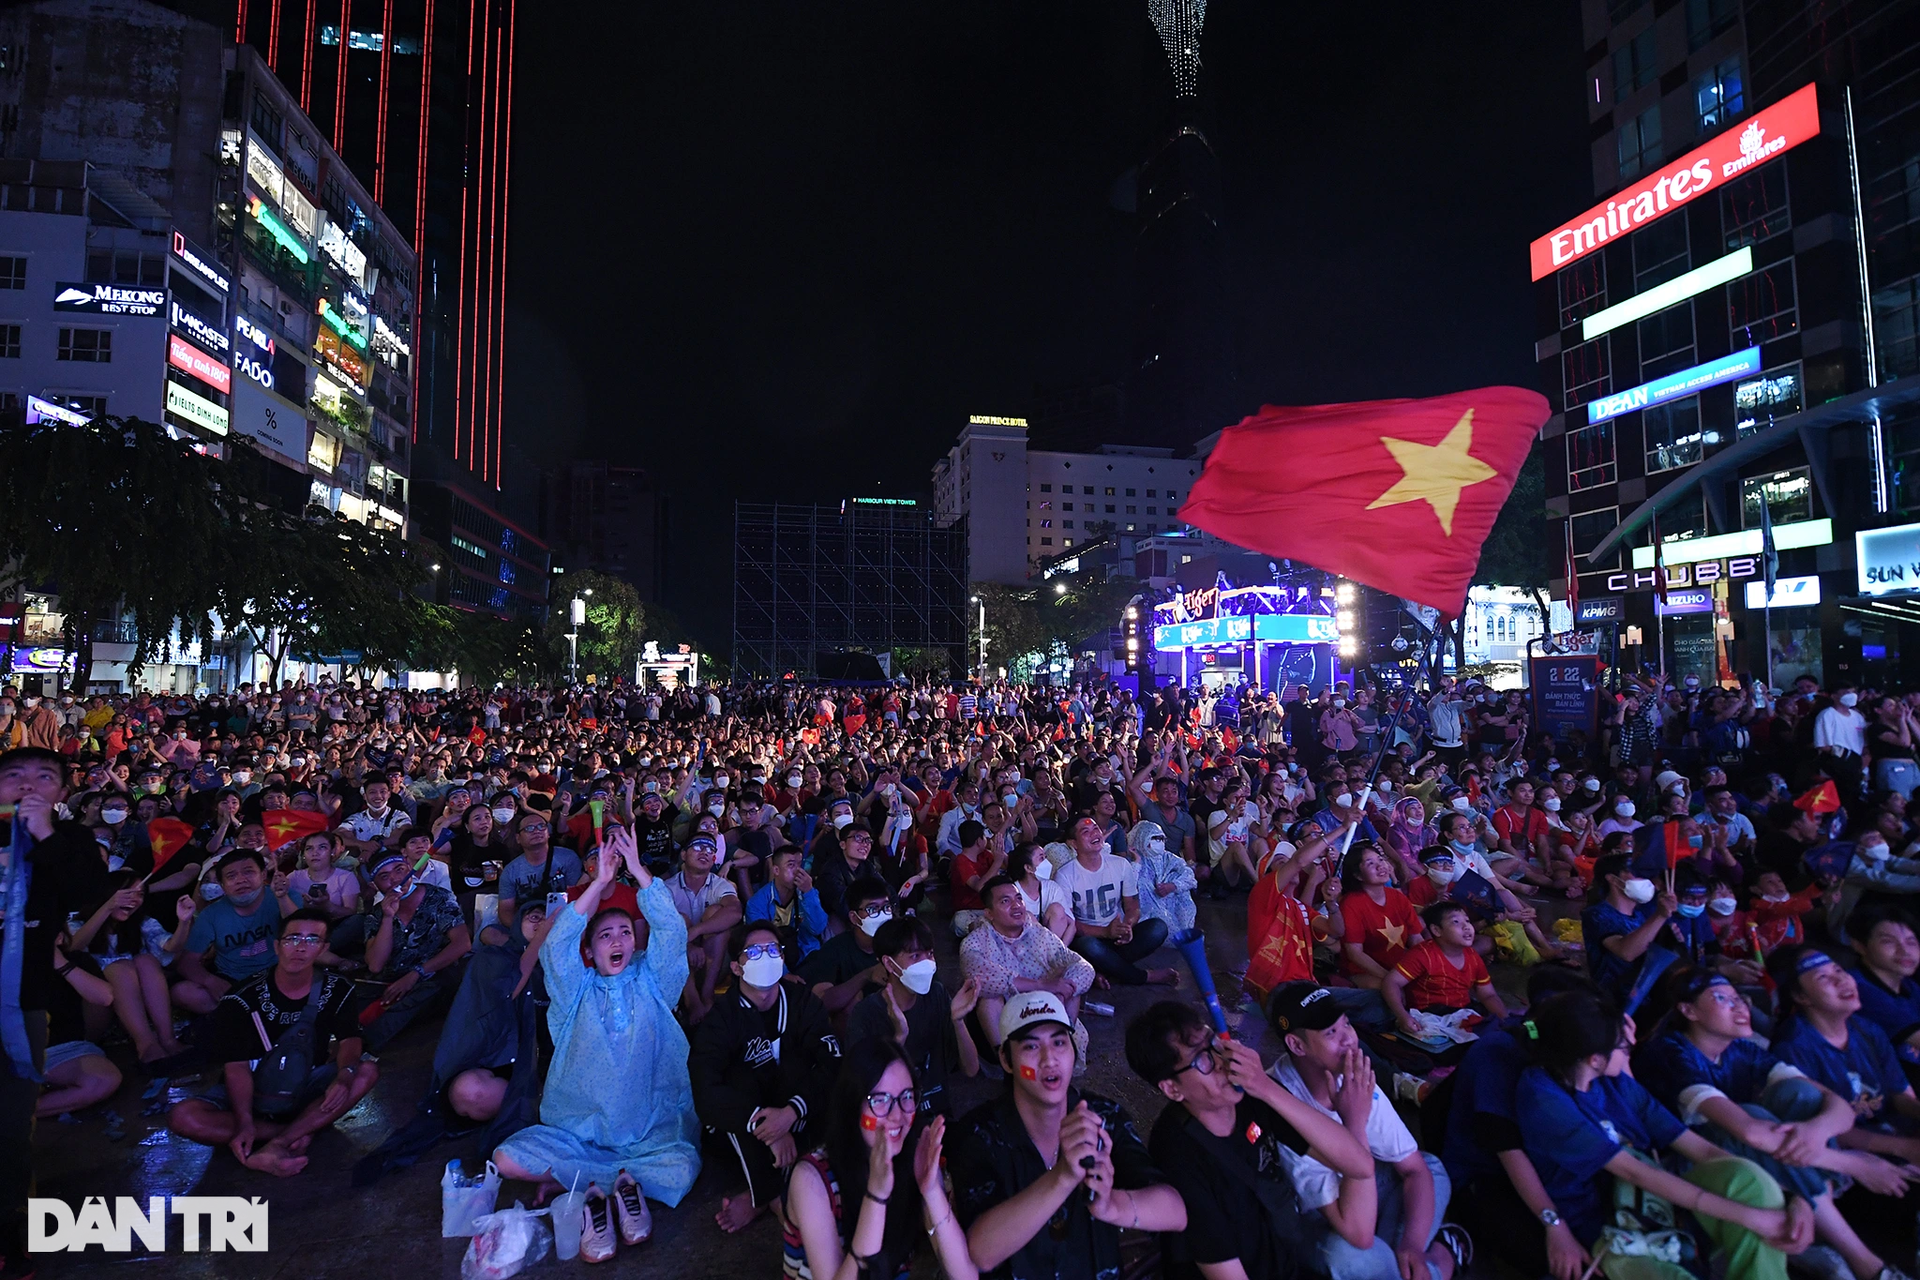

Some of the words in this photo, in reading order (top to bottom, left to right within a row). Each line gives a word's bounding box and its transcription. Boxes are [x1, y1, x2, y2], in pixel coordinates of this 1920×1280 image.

[1723, 134, 1786, 177] Emirates
[1550, 157, 1713, 266] Emirates
[184, 249, 229, 292] DREAMPLEX
[94, 285, 164, 305] MEKONG
[102, 303, 127, 313] REST
[130, 305, 157, 315] STOP
[179, 308, 230, 351] LANCASTER
[171, 343, 194, 369] Tiếng
[234, 351, 272, 388] FADO
[1595, 386, 1649, 420] DEAN
[1654, 382, 1686, 398] VIETNAM
[1687, 373, 1713, 387] ACCESS
[1714, 361, 1750, 380] AMERICA
[178, 397, 196, 413] IELTS
[213, 414, 228, 429] LONG
[970, 414, 990, 425] SAIGON
[257, 429, 273, 442] COMING
[273, 437, 284, 447] SOON
[1608, 558, 1756, 591] CHUBB
[1866, 564, 1904, 584] SUN
[1184, 588, 1216, 618] Tiger
[1582, 606, 1617, 618] KPMG
[1558, 631, 1595, 651] Tiger
[225, 924, 273, 948] NASA
